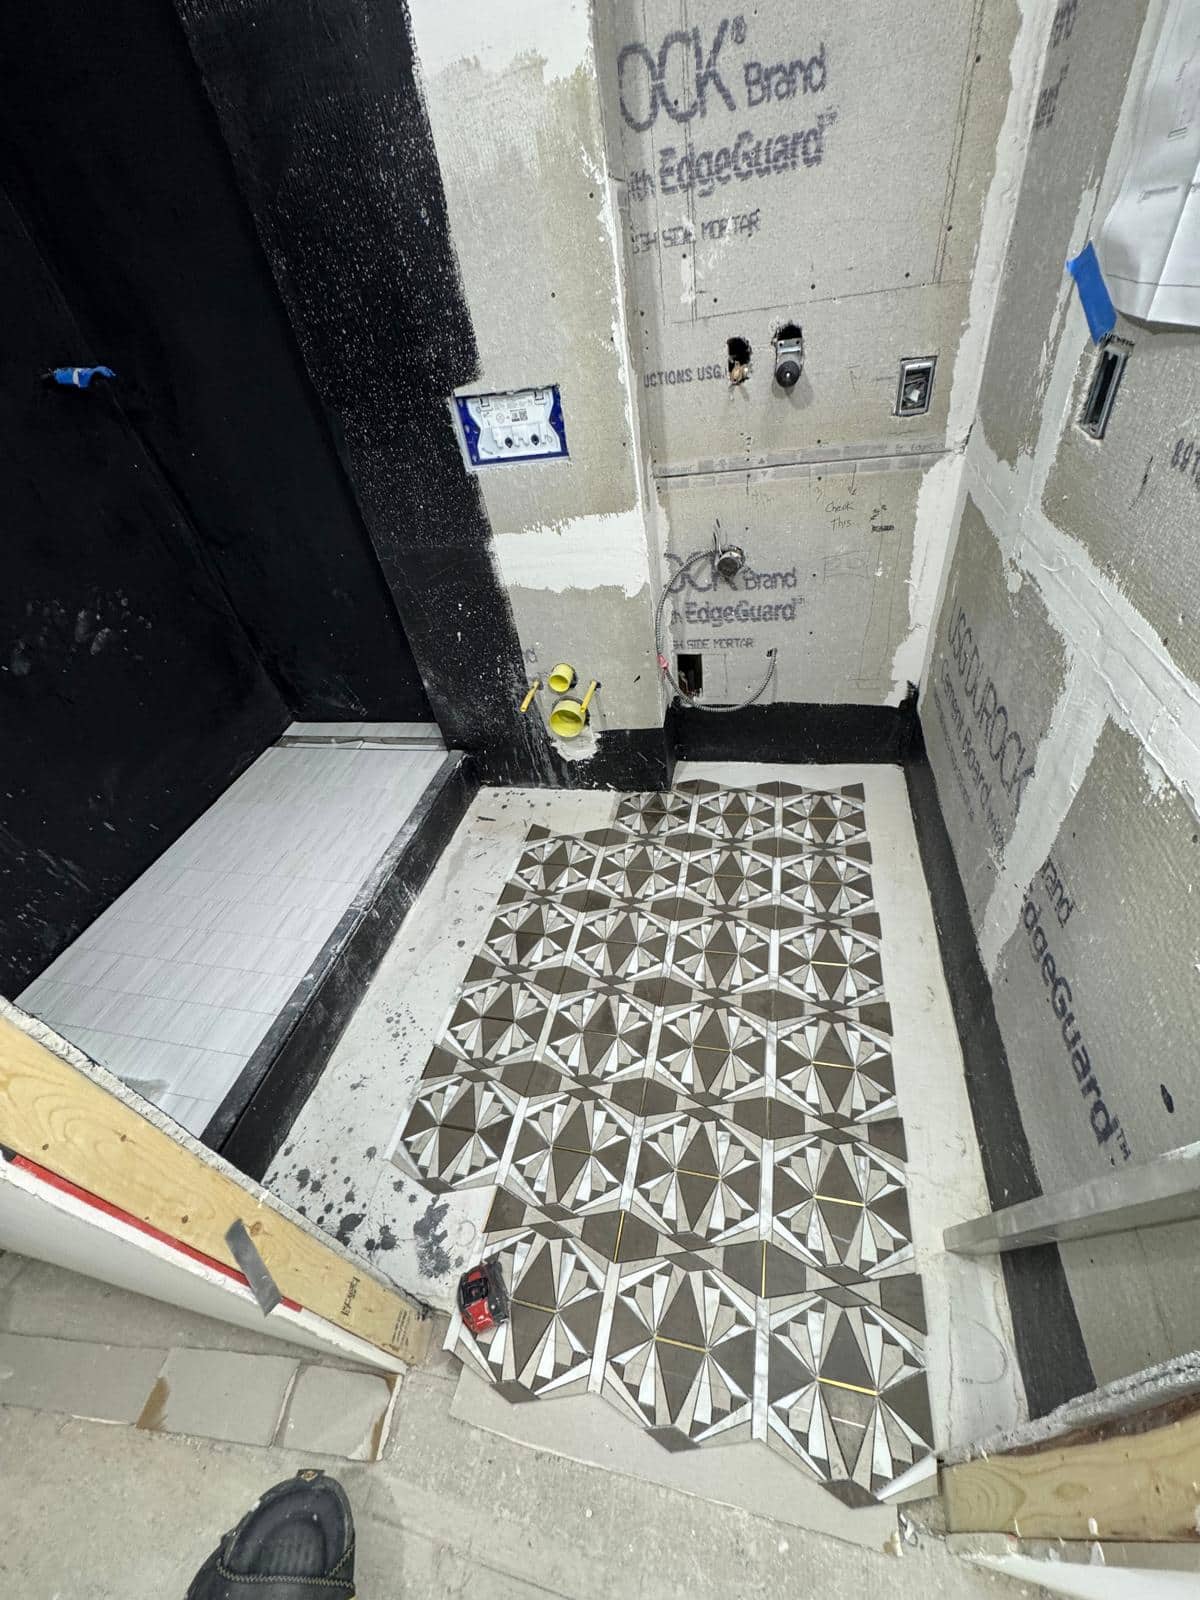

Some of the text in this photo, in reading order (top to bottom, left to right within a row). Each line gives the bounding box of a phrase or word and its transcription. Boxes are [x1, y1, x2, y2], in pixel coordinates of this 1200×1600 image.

[744, 42, 826, 107] Brand
[643, 368, 692, 388] UCTIONS
[742, 566, 797, 591] Brand
[713, 637, 754, 649] MORTAR
[941, 659, 965, 742] Cement
[962, 726, 993, 812] Board
